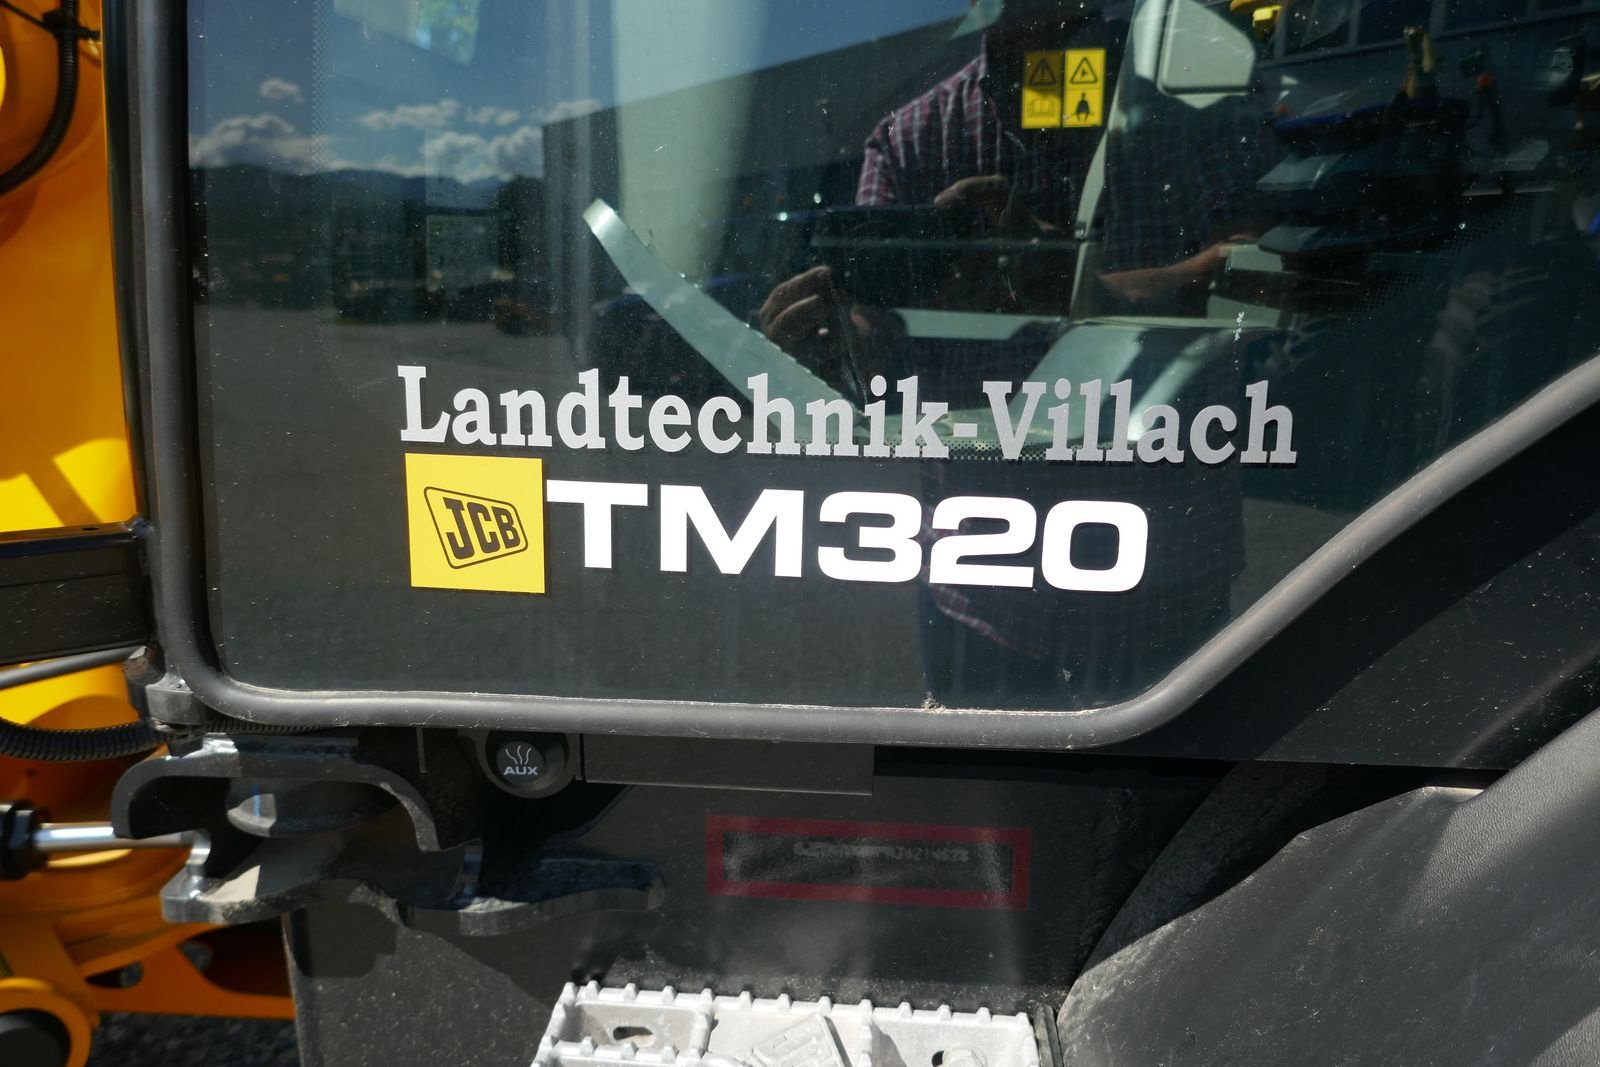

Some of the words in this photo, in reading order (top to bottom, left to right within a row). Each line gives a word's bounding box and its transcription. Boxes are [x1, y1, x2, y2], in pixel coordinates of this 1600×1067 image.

[398, 365, 1297, 464] Landtechnik-Villach
[442, 496, 521, 560] JCB
[546, 479, 1149, 592] TM320
[503, 766, 539, 776] AUX
